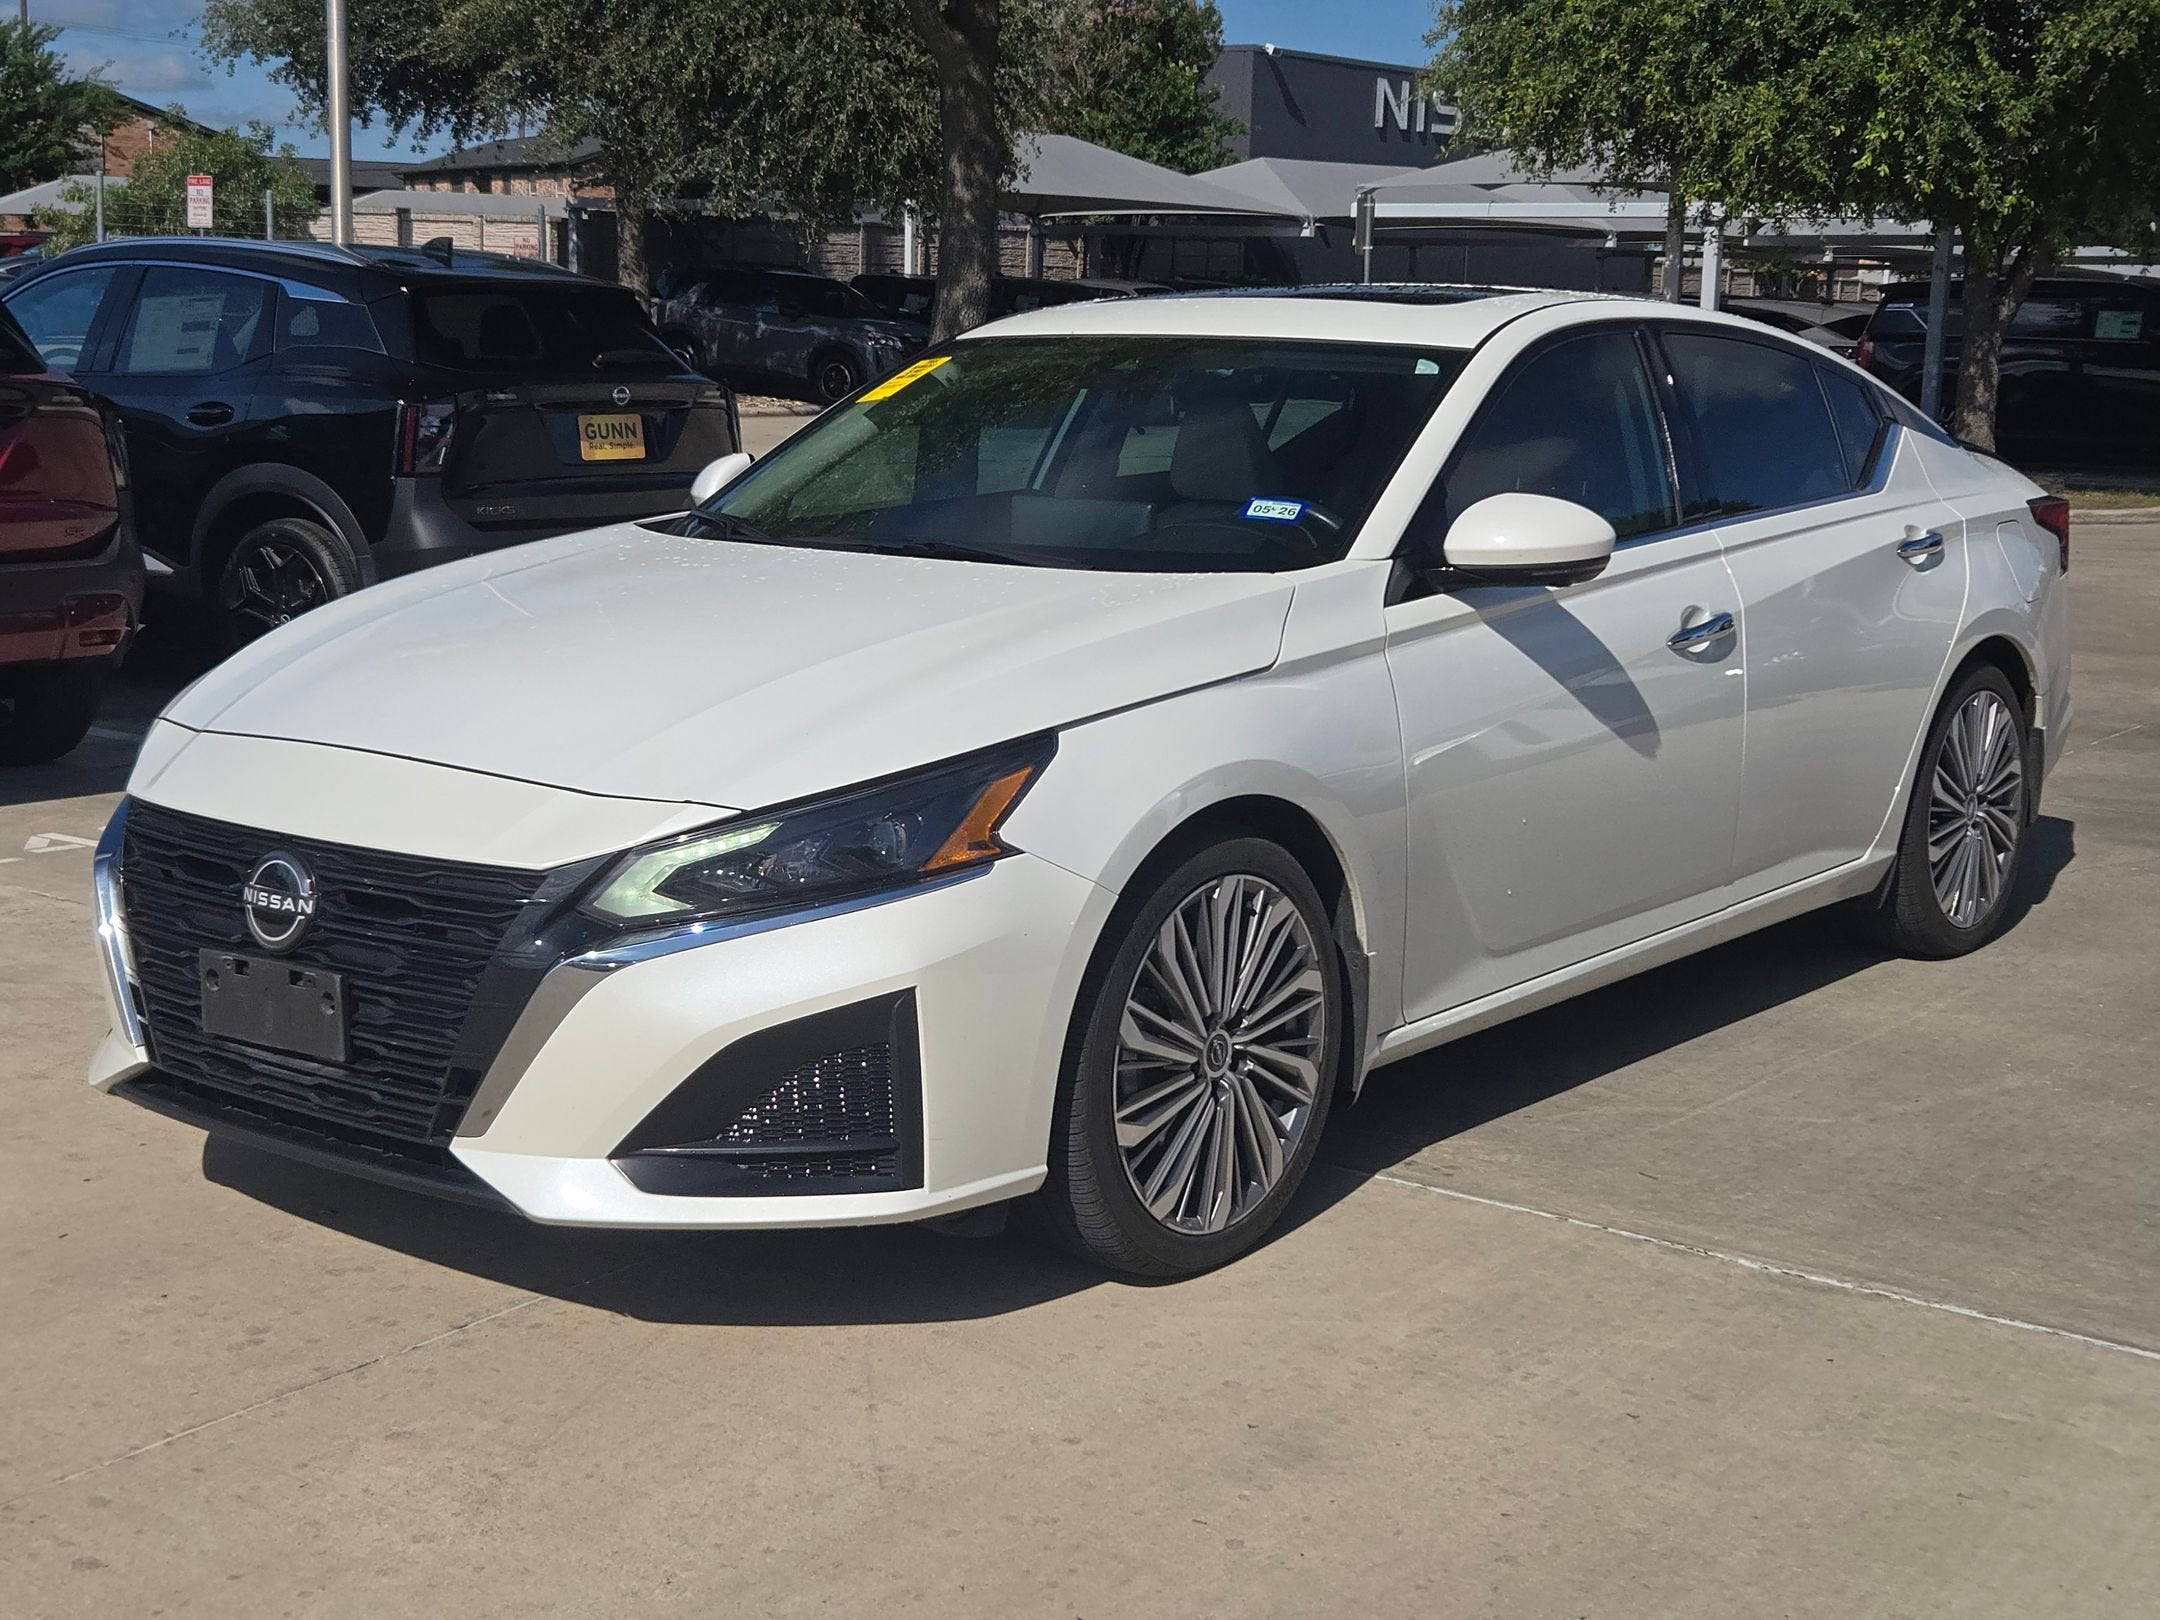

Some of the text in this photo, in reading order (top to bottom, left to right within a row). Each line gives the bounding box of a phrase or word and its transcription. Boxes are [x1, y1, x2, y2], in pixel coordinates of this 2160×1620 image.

[1374, 77, 1462, 135] NIS
[189, 196, 211, 205] PARKING
[585, 422, 637, 440] GUNN
[1253, 505, 1271, 514] 05
[1277, 507, 1297, 516] 26
[243, 886, 314, 914] NISSAN
